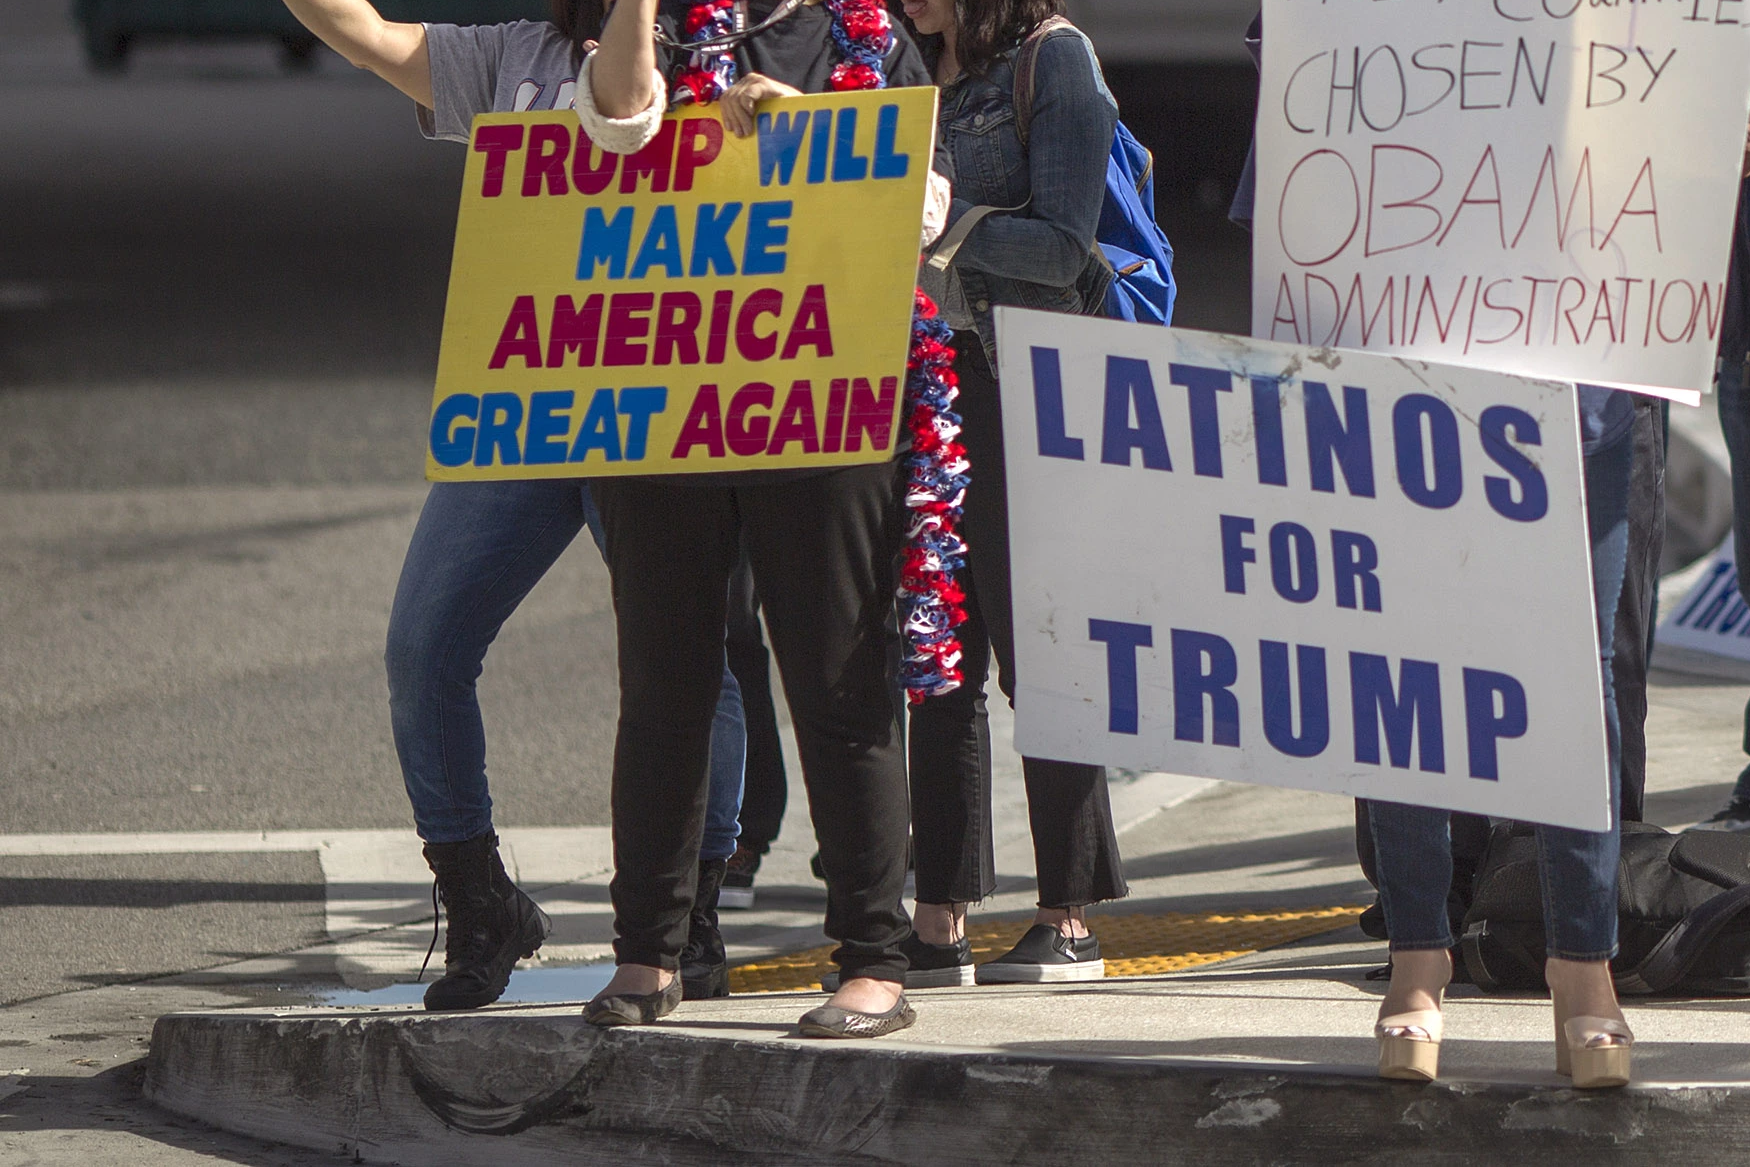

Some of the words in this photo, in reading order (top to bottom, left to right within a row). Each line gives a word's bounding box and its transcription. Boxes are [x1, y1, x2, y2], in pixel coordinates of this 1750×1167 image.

[1283, 36, 1556, 138] CHOSEN
[1585, 40, 1678, 110] BY
[474, 117, 724, 198] TRUMP
[757, 104, 909, 187] WILL
[575, 200, 793, 280] MAKE
[1278, 143, 1664, 267] OBAMA
[488, 284, 835, 370] AMERICA
[1270, 272, 1723, 355] ADMINISTRATION
[429, 387, 668, 467] GREAT
[671, 376, 898, 460] AGAIN
[1030, 345, 1549, 523] LATINOS
[1219, 514, 1383, 613] FOR
[1088, 617, 1529, 782] TRUMP
